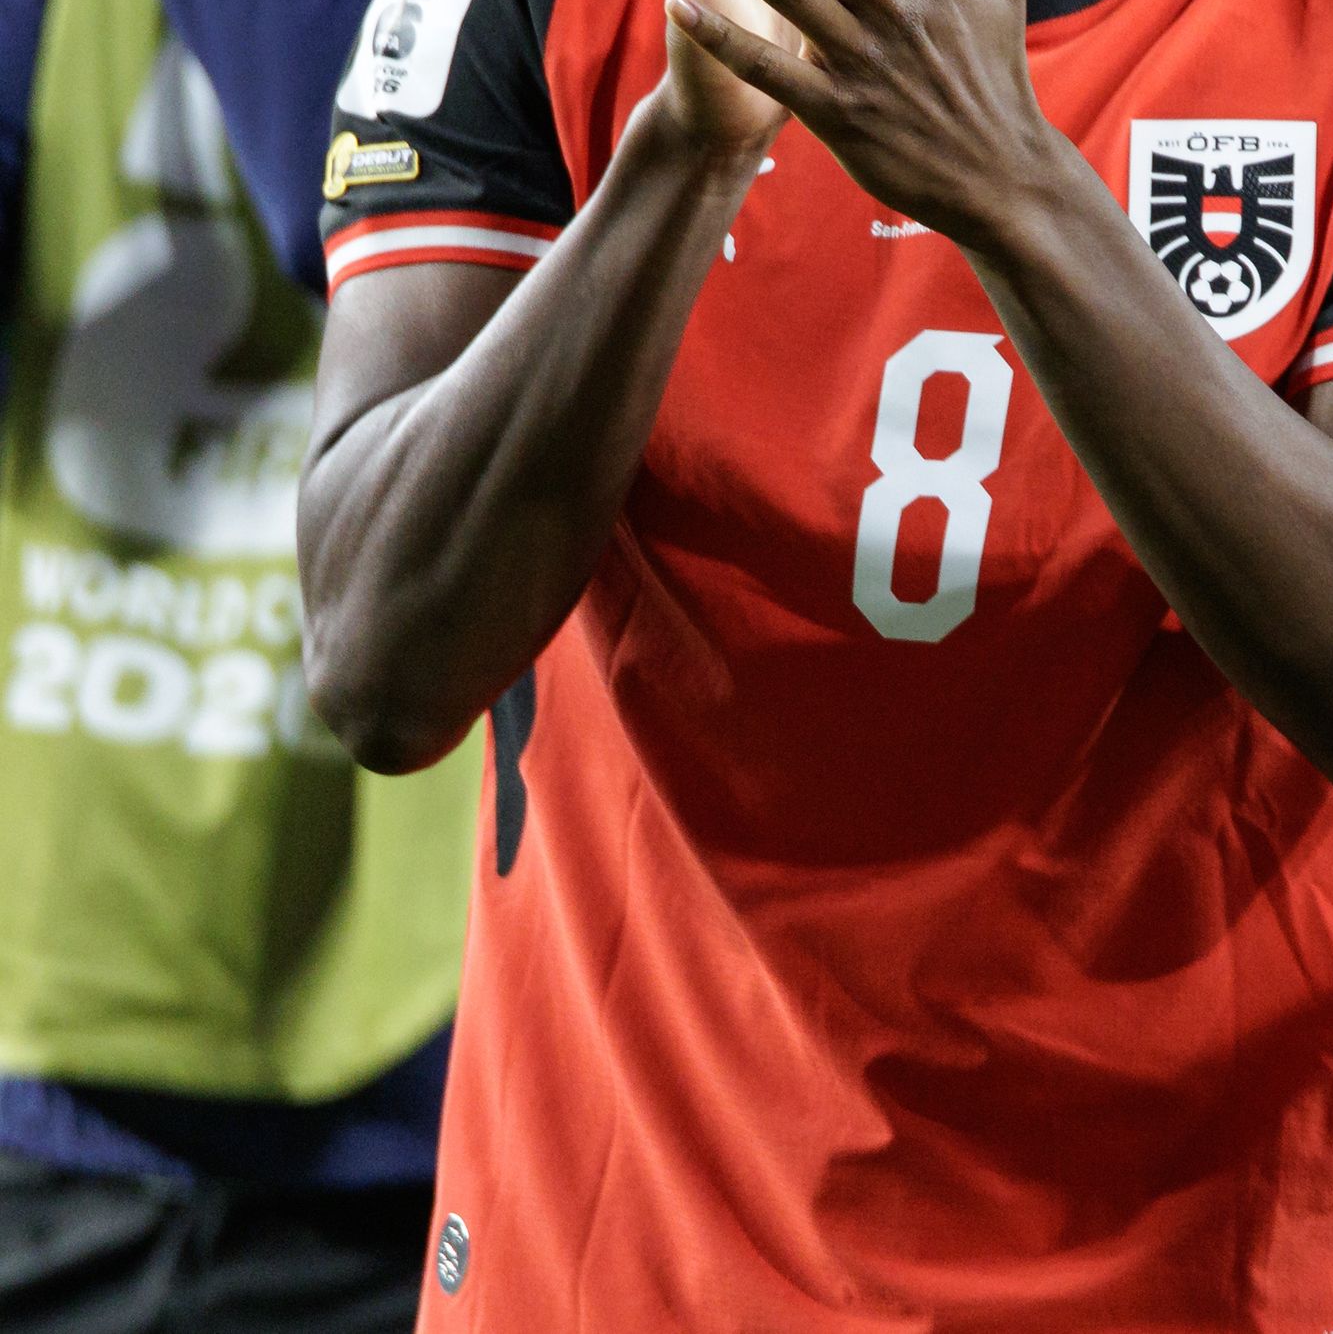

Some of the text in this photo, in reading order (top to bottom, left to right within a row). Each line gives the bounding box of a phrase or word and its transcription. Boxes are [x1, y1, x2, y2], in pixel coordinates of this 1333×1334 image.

[1187, 131, 1260, 152] ÖFB
[853, 329, 1014, 643] 8
[19, 544, 248, 648] WORLD
